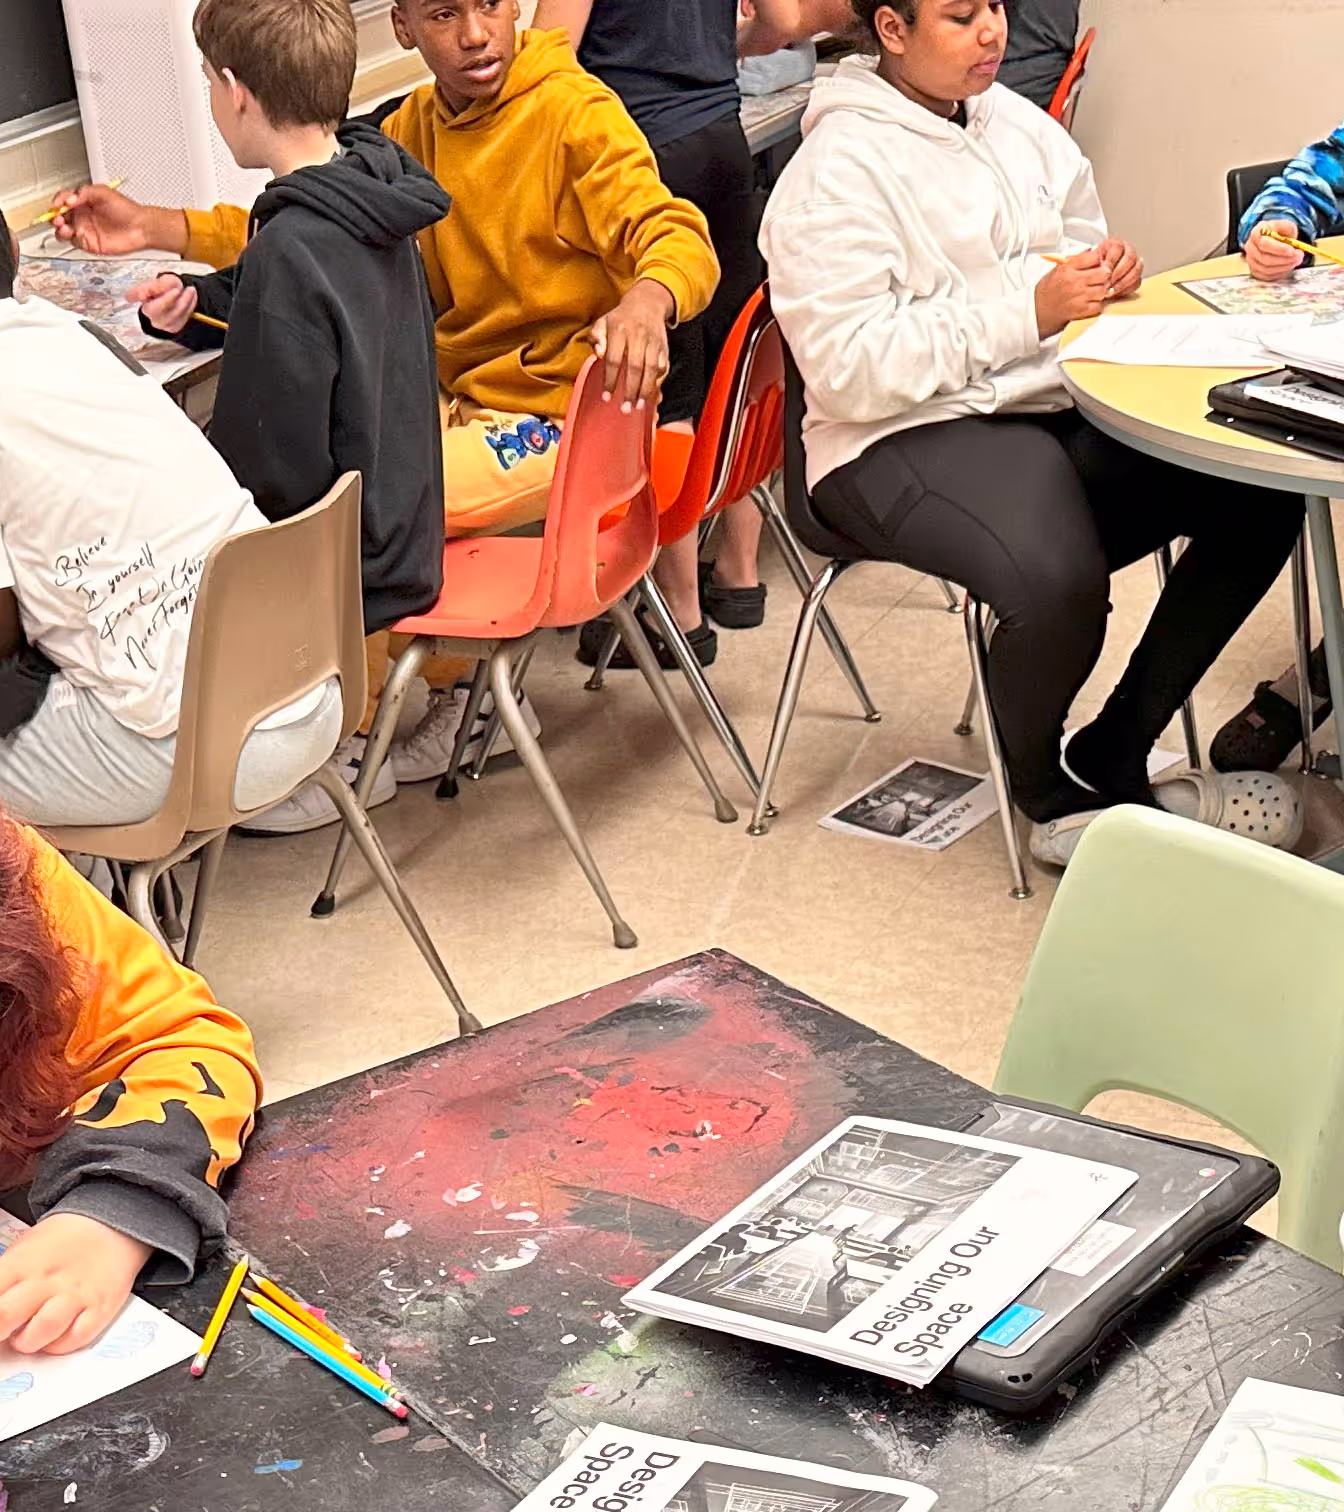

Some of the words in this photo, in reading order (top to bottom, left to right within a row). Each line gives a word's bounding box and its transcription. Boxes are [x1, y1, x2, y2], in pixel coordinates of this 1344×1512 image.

[55, 536, 107, 587] Believe
[108, 542, 155, 594] yourself
[171, 557, 205, 590] Goin
[849, 1261, 972, 1346] Designing
[949, 1226, 1000, 1258] Our
[893, 1303, 973, 1357] Space
[550, 1442, 634, 1509] Space
